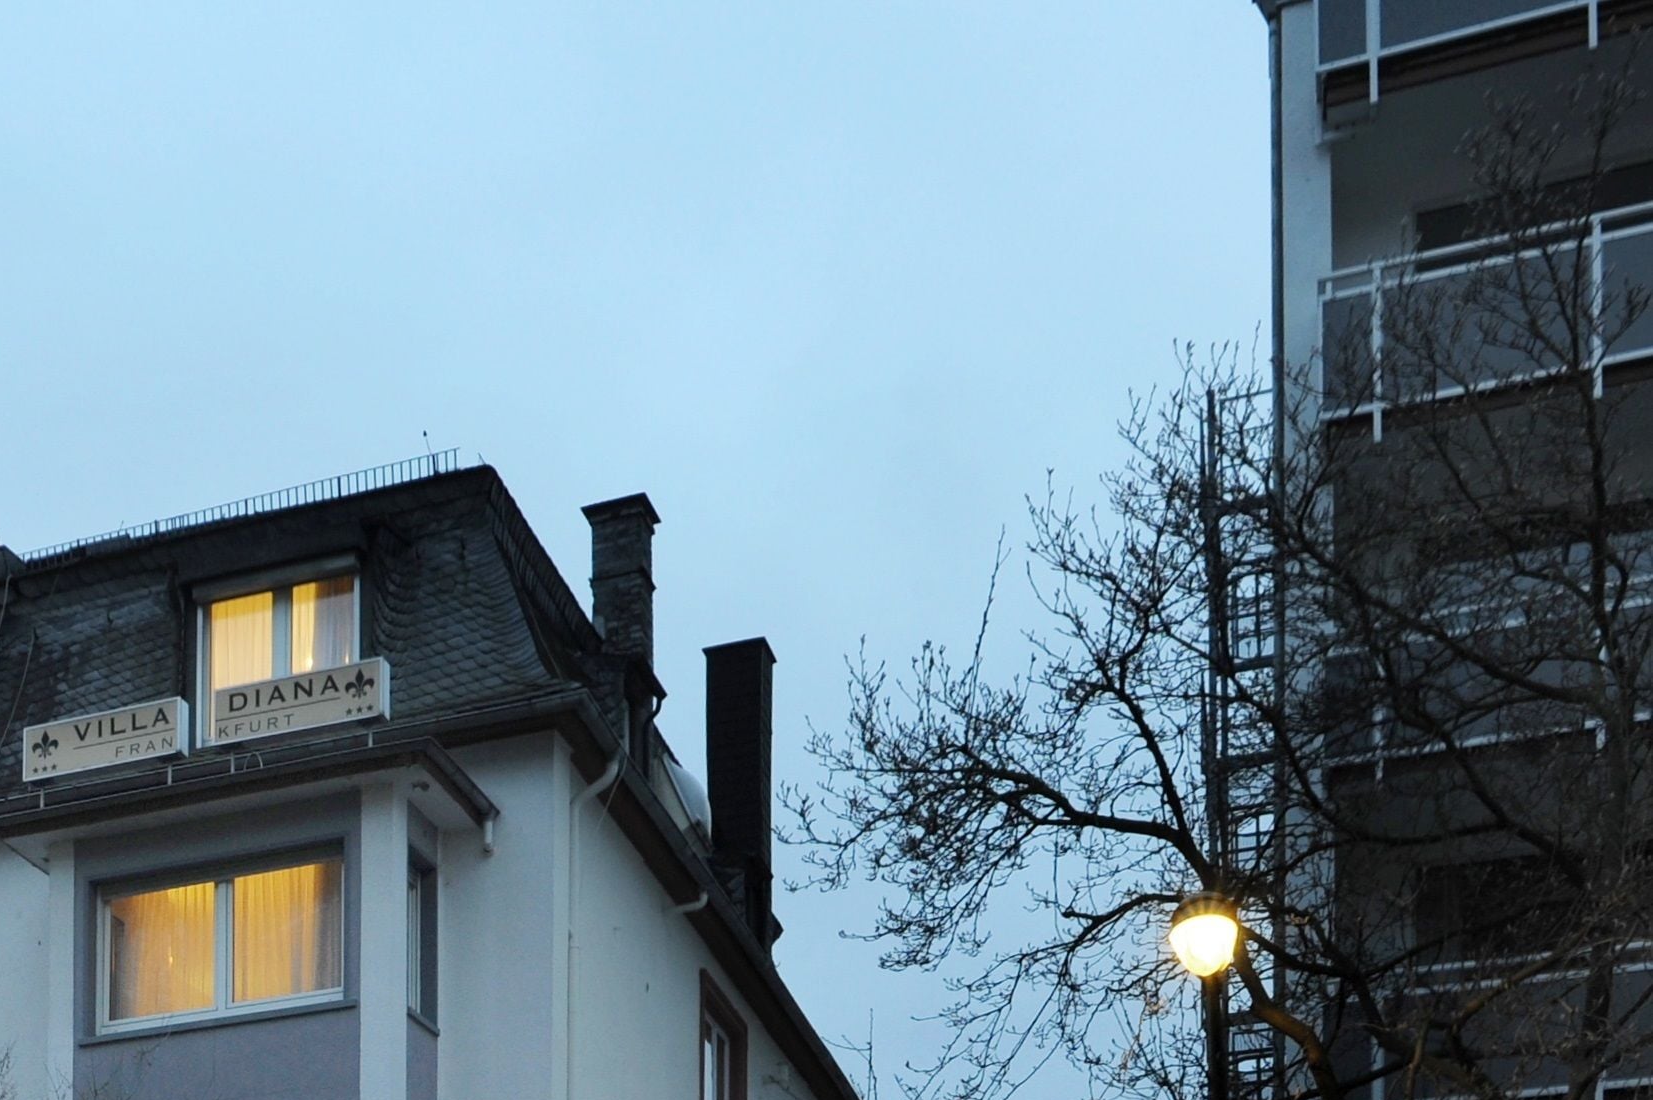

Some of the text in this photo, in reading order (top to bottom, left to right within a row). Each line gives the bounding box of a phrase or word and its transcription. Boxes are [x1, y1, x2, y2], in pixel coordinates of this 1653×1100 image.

[228, 674, 341, 713] DIANA
[73, 707, 171, 742] VILLA
[218, 713, 295, 739] KFURT
[115, 736, 175, 758] FRAN
